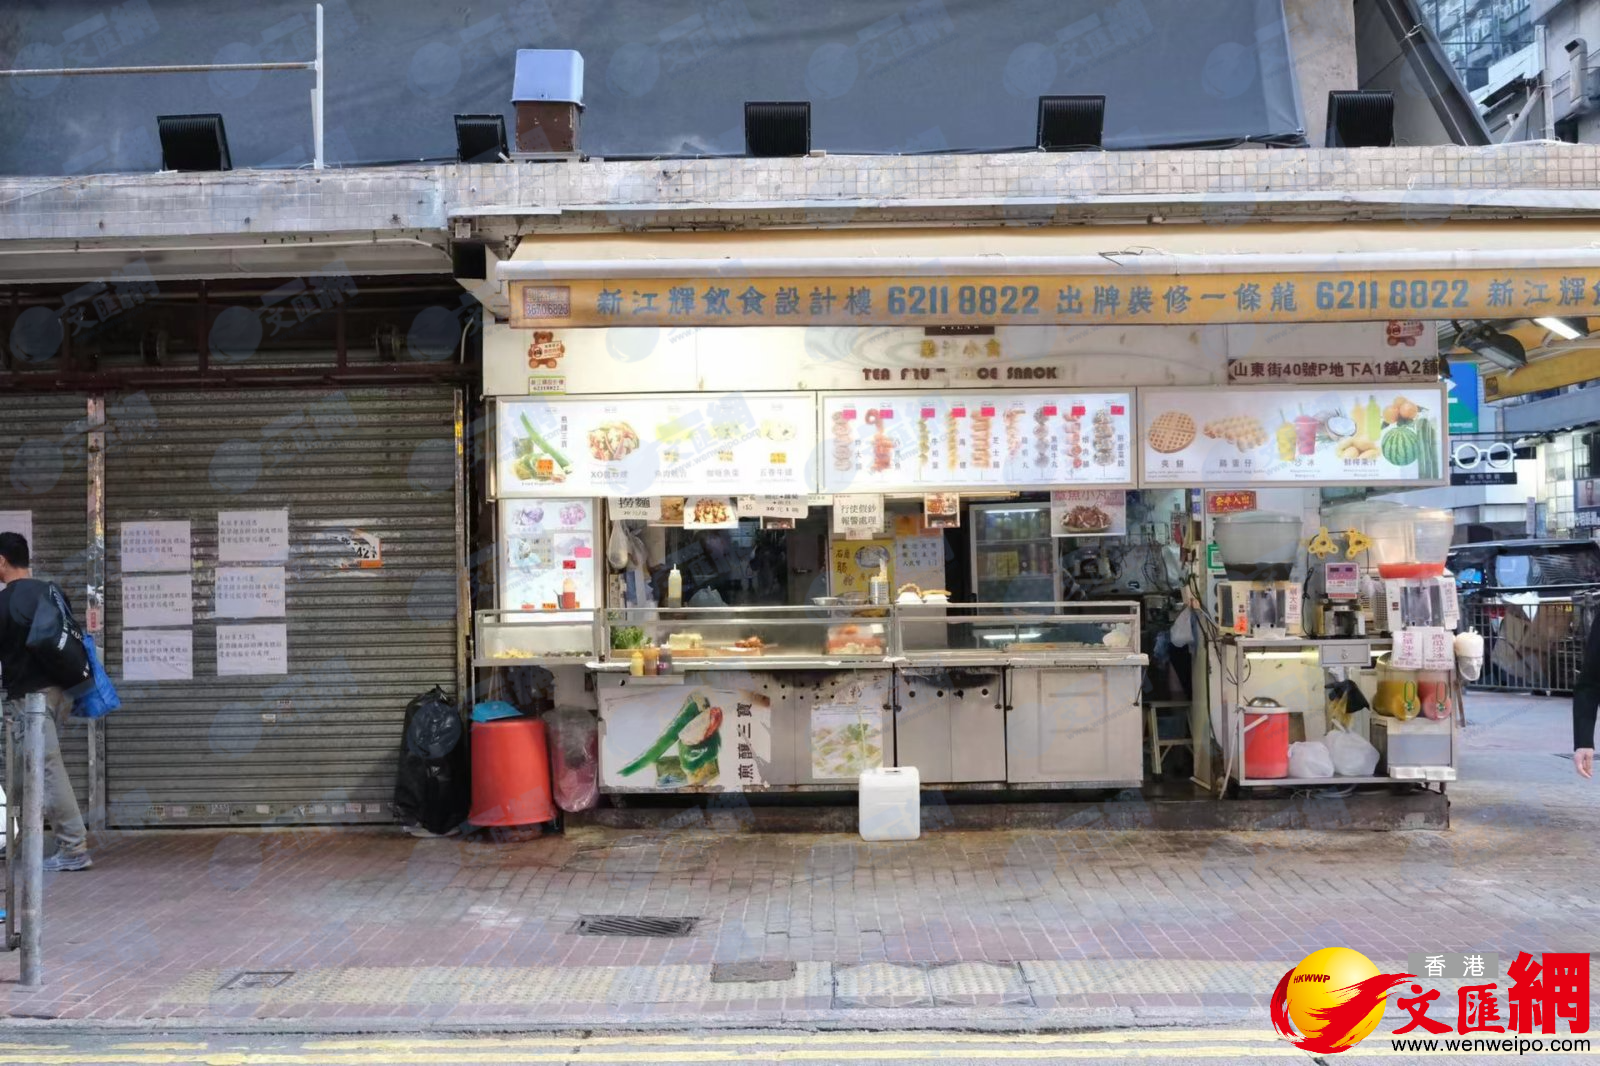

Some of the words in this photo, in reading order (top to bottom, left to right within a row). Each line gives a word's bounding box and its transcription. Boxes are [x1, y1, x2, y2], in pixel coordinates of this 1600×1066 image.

[597, 285, 872, 316] 新江輝飲食設計樓
[888, 286, 949, 315] 6211
[958, 286, 1040, 315] 8822
[1056, 281, 1298, 315] 出牌裝修一條龍
[1316, 280, 1377, 310] 6211
[1389, 280, 1469, 310] 8822
